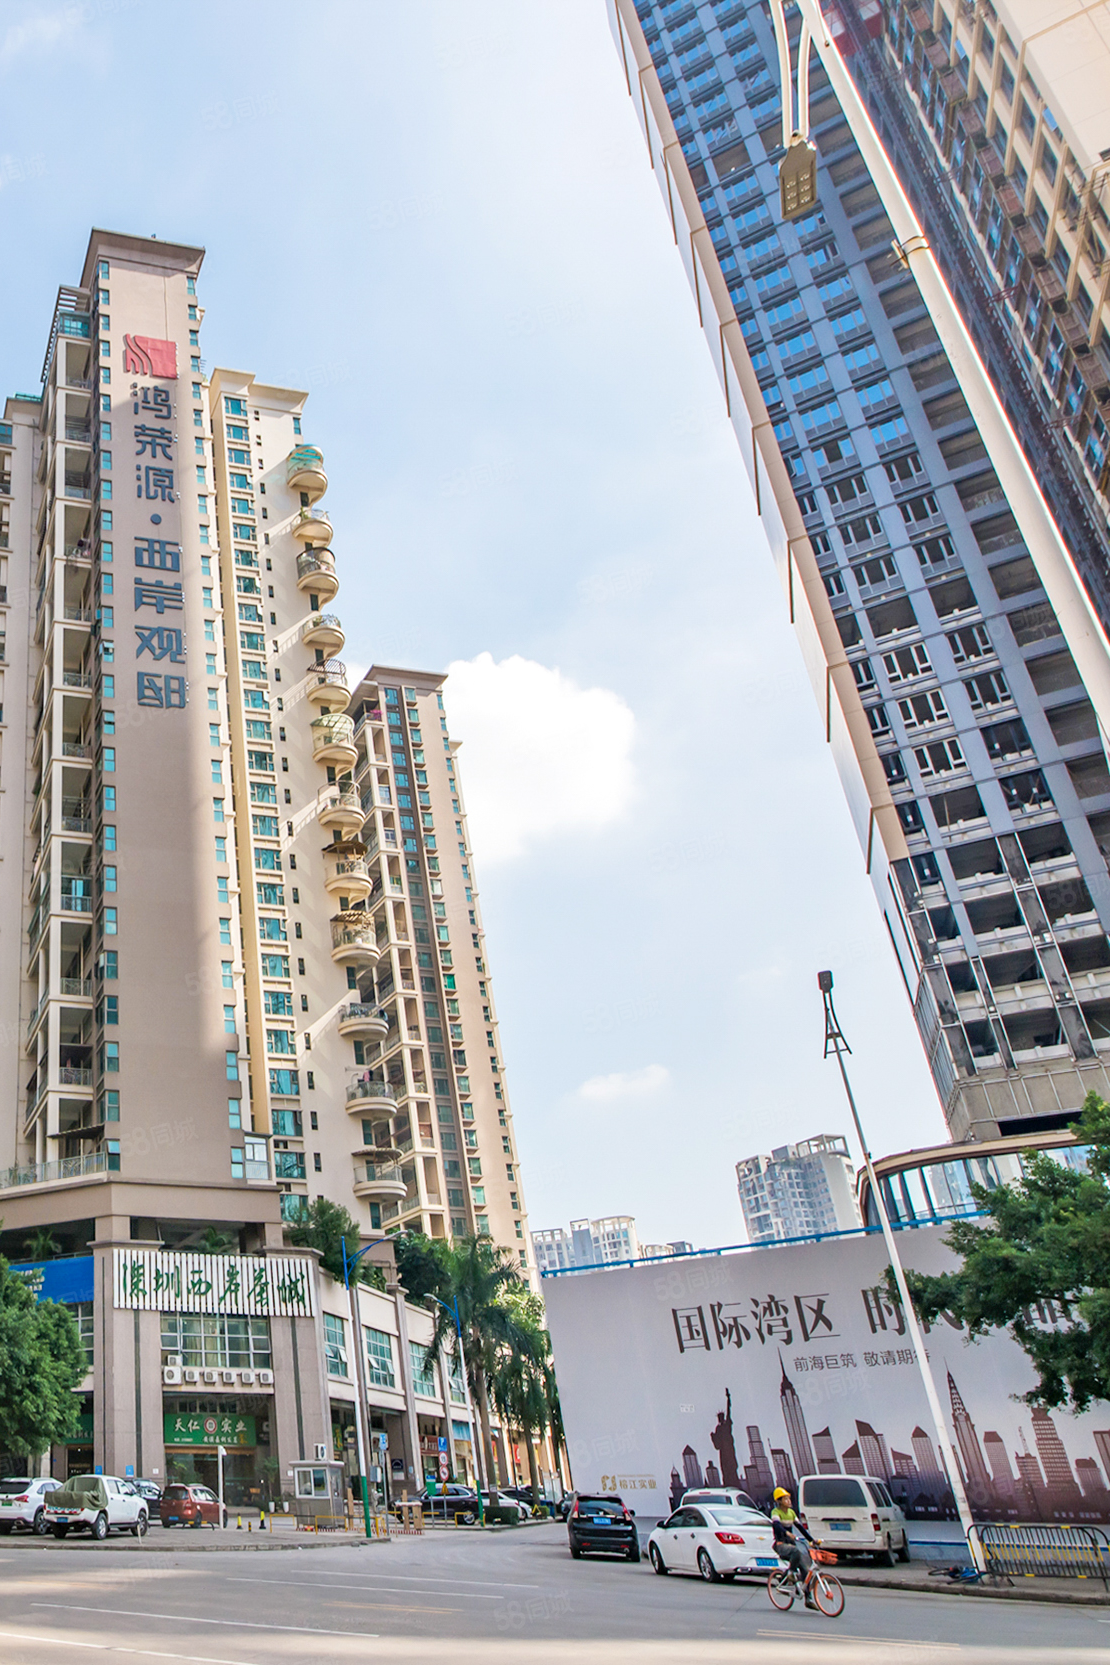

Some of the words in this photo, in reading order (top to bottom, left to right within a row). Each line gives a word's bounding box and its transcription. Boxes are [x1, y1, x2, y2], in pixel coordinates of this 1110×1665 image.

[672, 1293, 841, 1353] 国际湾区
[793, 1353, 857, 1372] 前海巨筑
[221, 1418, 247, 1433] 实业
